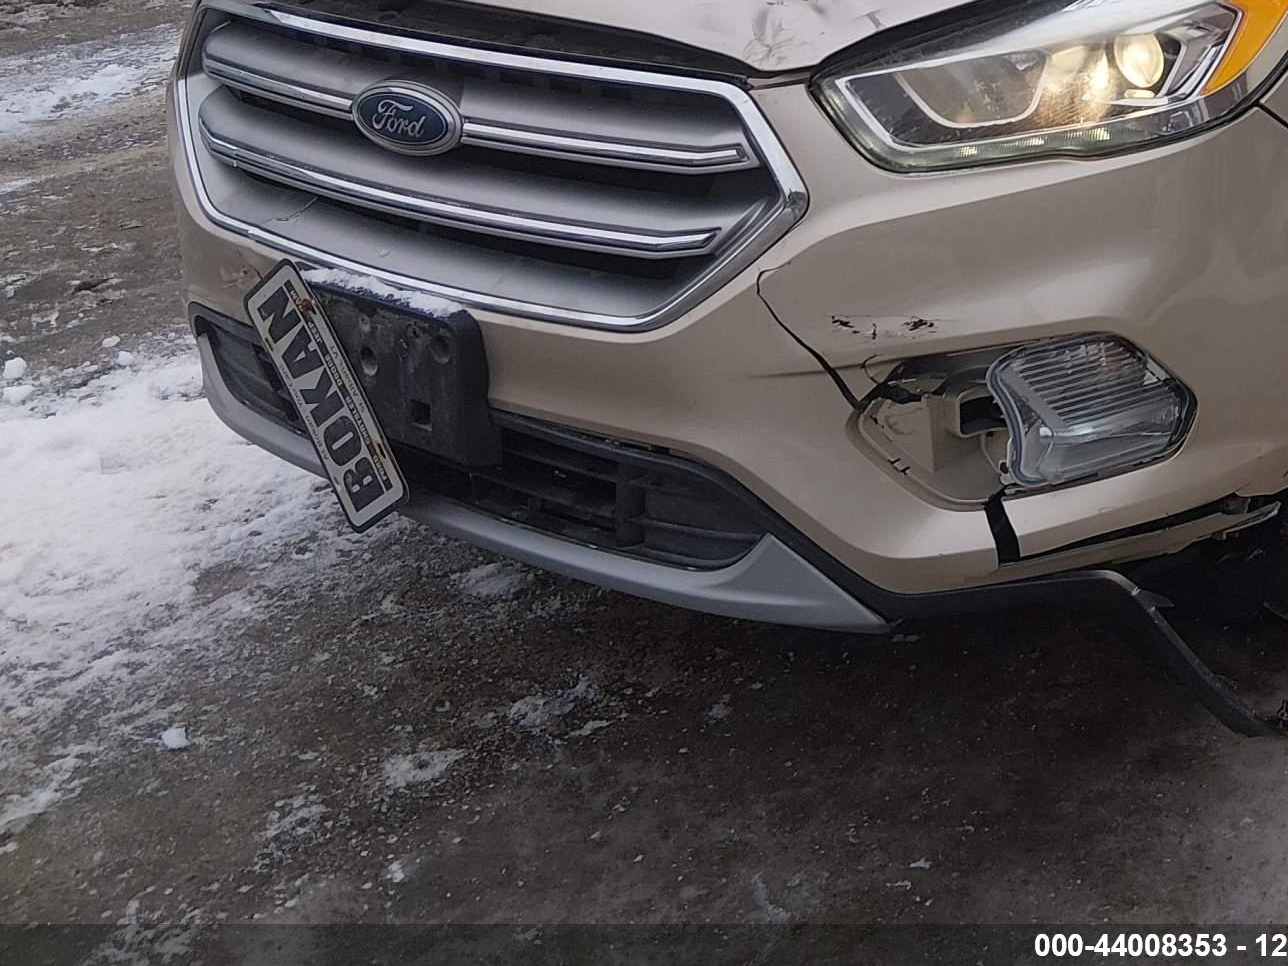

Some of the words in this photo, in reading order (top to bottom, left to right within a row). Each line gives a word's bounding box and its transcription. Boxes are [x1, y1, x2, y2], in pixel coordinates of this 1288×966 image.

[372, 99, 426, 138] Ford
[307, 320, 323, 345] JEEP
[323, 353, 343, 386] DODGE
[257, 286, 386, 512] BOKAN
[344, 394, 371, 444] CHRYSLER
[371, 453, 387, 480] FORD
